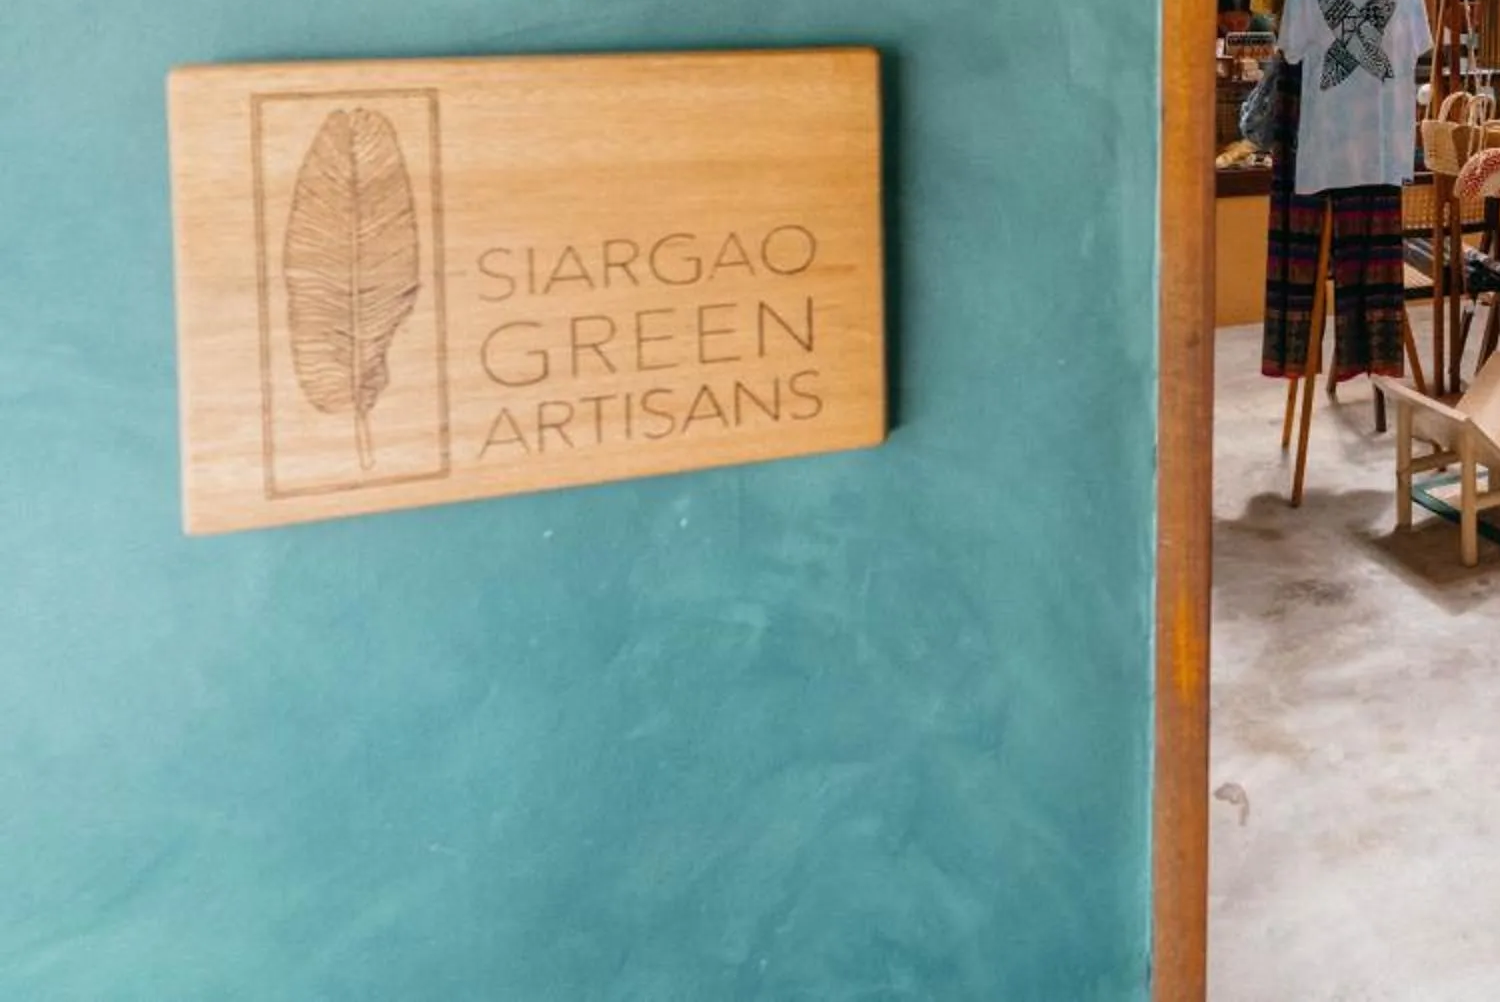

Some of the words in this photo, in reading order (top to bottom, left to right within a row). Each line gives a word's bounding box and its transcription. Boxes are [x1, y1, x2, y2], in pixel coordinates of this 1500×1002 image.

[476, 224, 818, 303] SIARGAO
[480, 296, 815, 389] GREEN
[478, 369, 824, 459] ARTISANS
